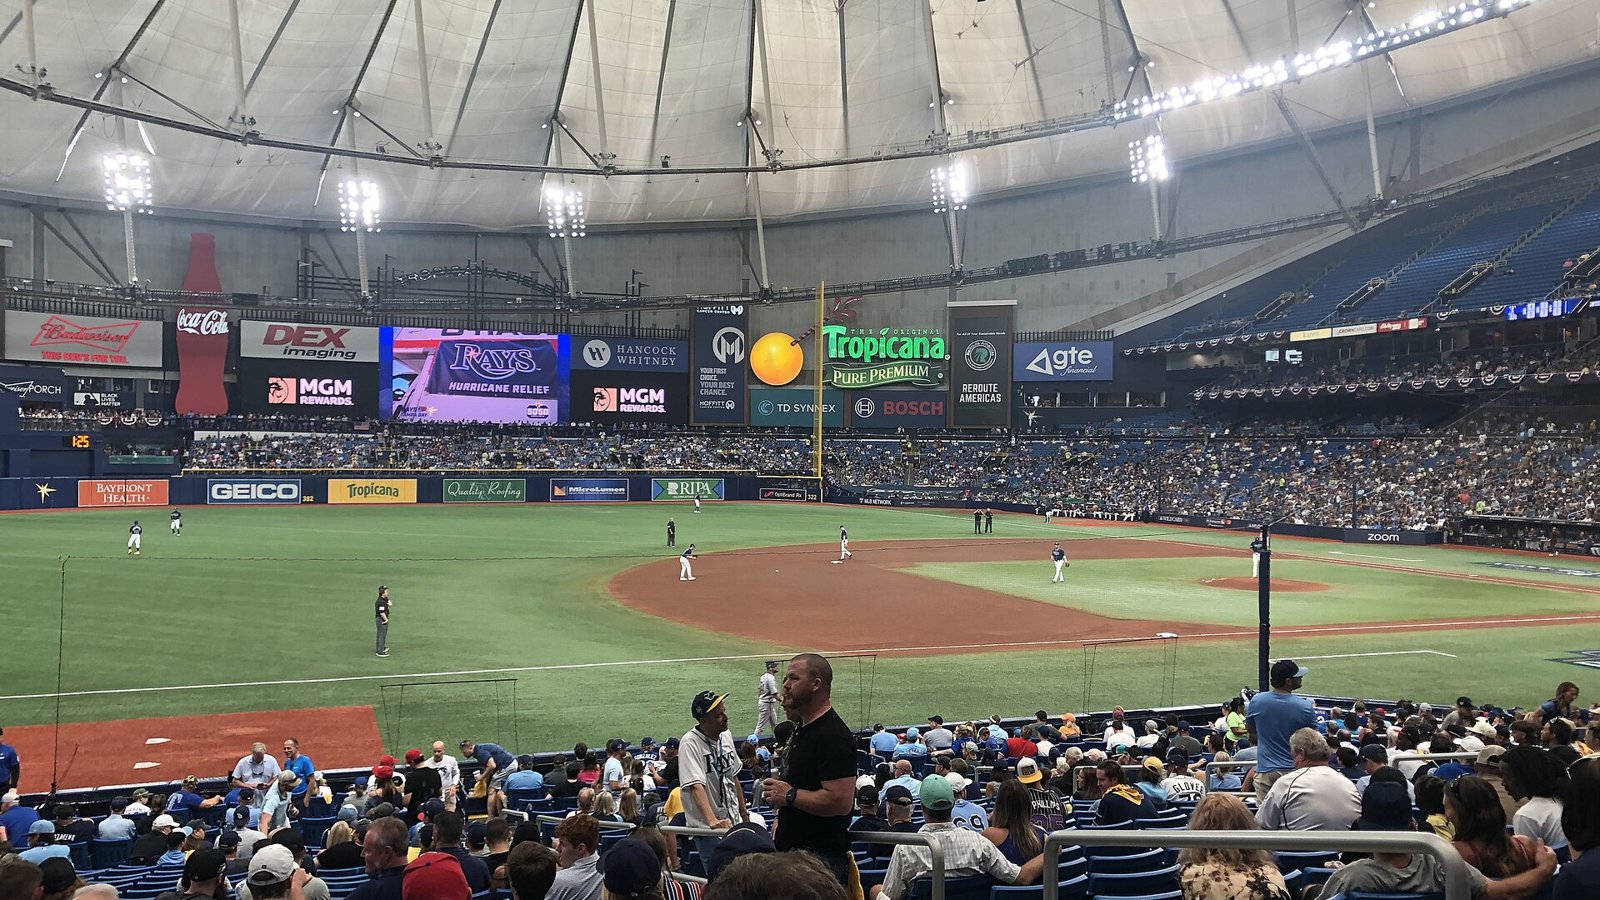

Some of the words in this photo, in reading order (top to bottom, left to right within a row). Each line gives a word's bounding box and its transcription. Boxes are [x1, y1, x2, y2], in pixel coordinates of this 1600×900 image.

[177, 308, 229, 335] Coca-Cola
[41, 323, 129, 343] Budweiser
[262, 324, 351, 351] DEX
[617, 345, 677, 355] HANCOCK
[822, 325, 945, 363] Tropicana
[283, 346, 357, 360] imaging
[1052, 346, 1093, 369] gte
[449, 343, 537, 380] RAYS
[617, 356, 677, 366] WHITNEY
[833, 370, 867, 385] PURE
[869, 365, 929, 382] PREMIUM
[1060, 365, 1098, 376] financial
[29, 385, 62, 394] PORCH
[299, 378, 352, 396] MGM
[449, 382, 510, 395] HURRICANE
[512, 384, 550, 395] RELIEF
[700, 381, 718, 389] YOUR
[718, 381, 735, 389] BEST
[962, 383, 998, 393] REROUTE
[619, 387, 665, 404] MGM
[700, 388, 727, 396] CHANCE.
[959, 393, 1002, 403] AMERICAS
[777, 403, 791, 412] TD
[793, 403, 836, 413] SYNNEX
[883, 400, 943, 416] BOSCH
[72, 435, 89, 448] 1:25
[96, 483, 153, 494] BAYFRONT
[211, 483, 299, 500] GEICO
[346, 482, 399, 499] Tropicana
[447, 481, 483, 500] Quality
[487, 481, 521, 499] Roofing
[680, 481, 712, 495] RIPA
[103, 493, 146, 504] HEALTH
[1367, 533, 1400, 542] zoom
[634, 753, 658, 761] GONZALEZ
[1031, 800, 1060, 812] PHILLIPS
